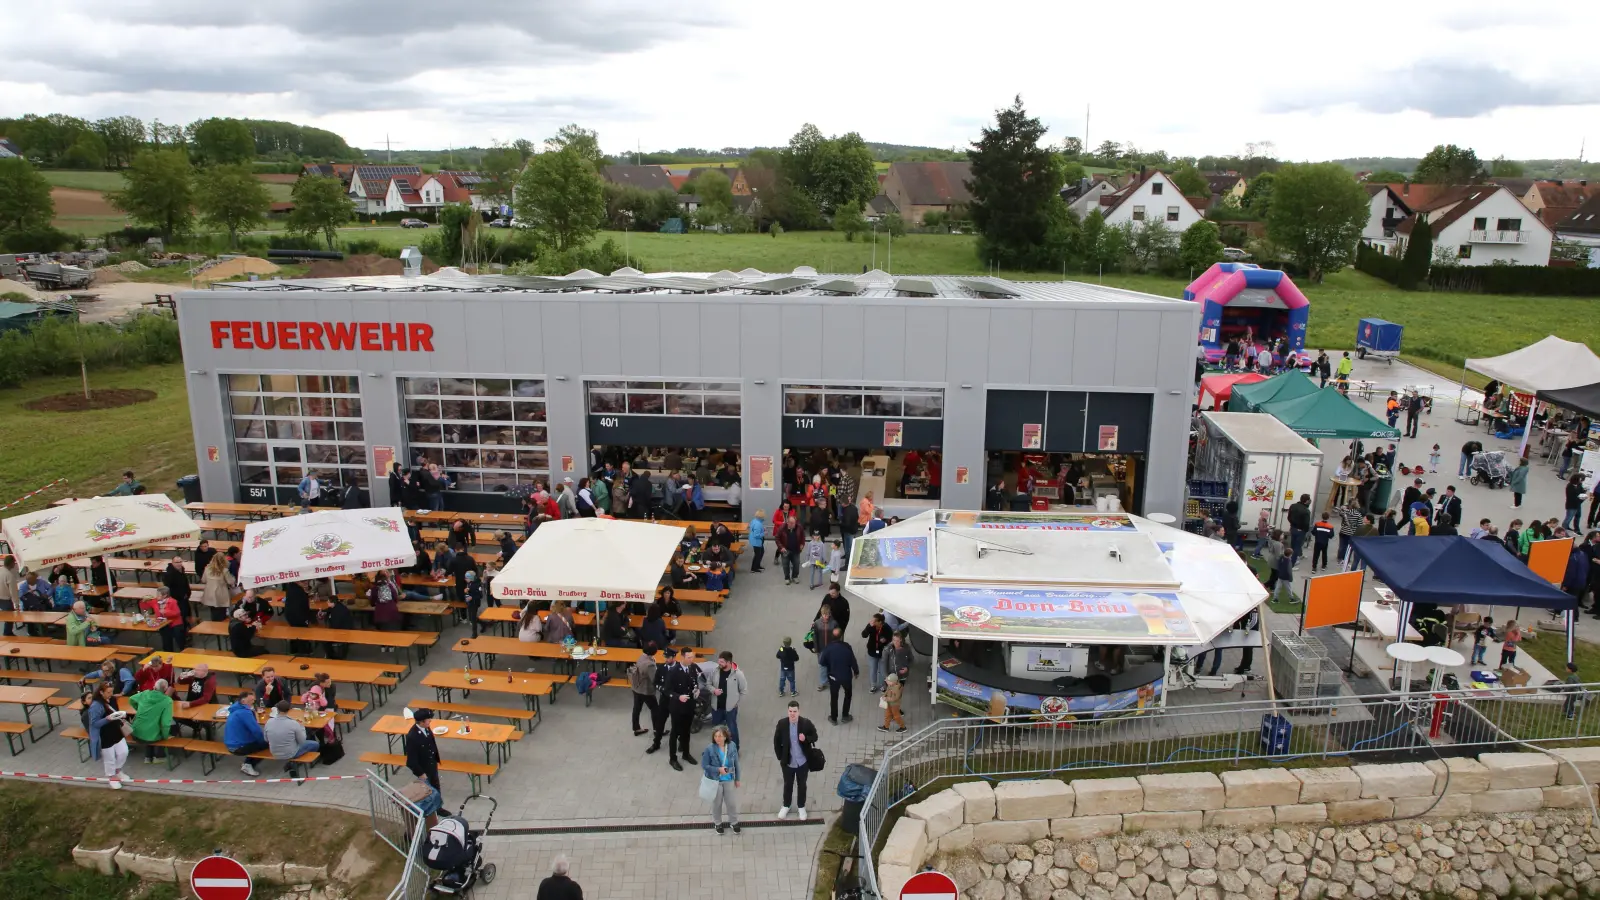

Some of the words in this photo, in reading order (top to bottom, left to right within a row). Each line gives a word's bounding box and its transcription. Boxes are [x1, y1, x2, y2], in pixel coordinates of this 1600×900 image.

[210, 321, 434, 351] FEUERWEHR
[600, 417, 618, 428] 40/1
[795, 418, 814, 429] 11/1
[250, 488, 267, 497] 55/1
